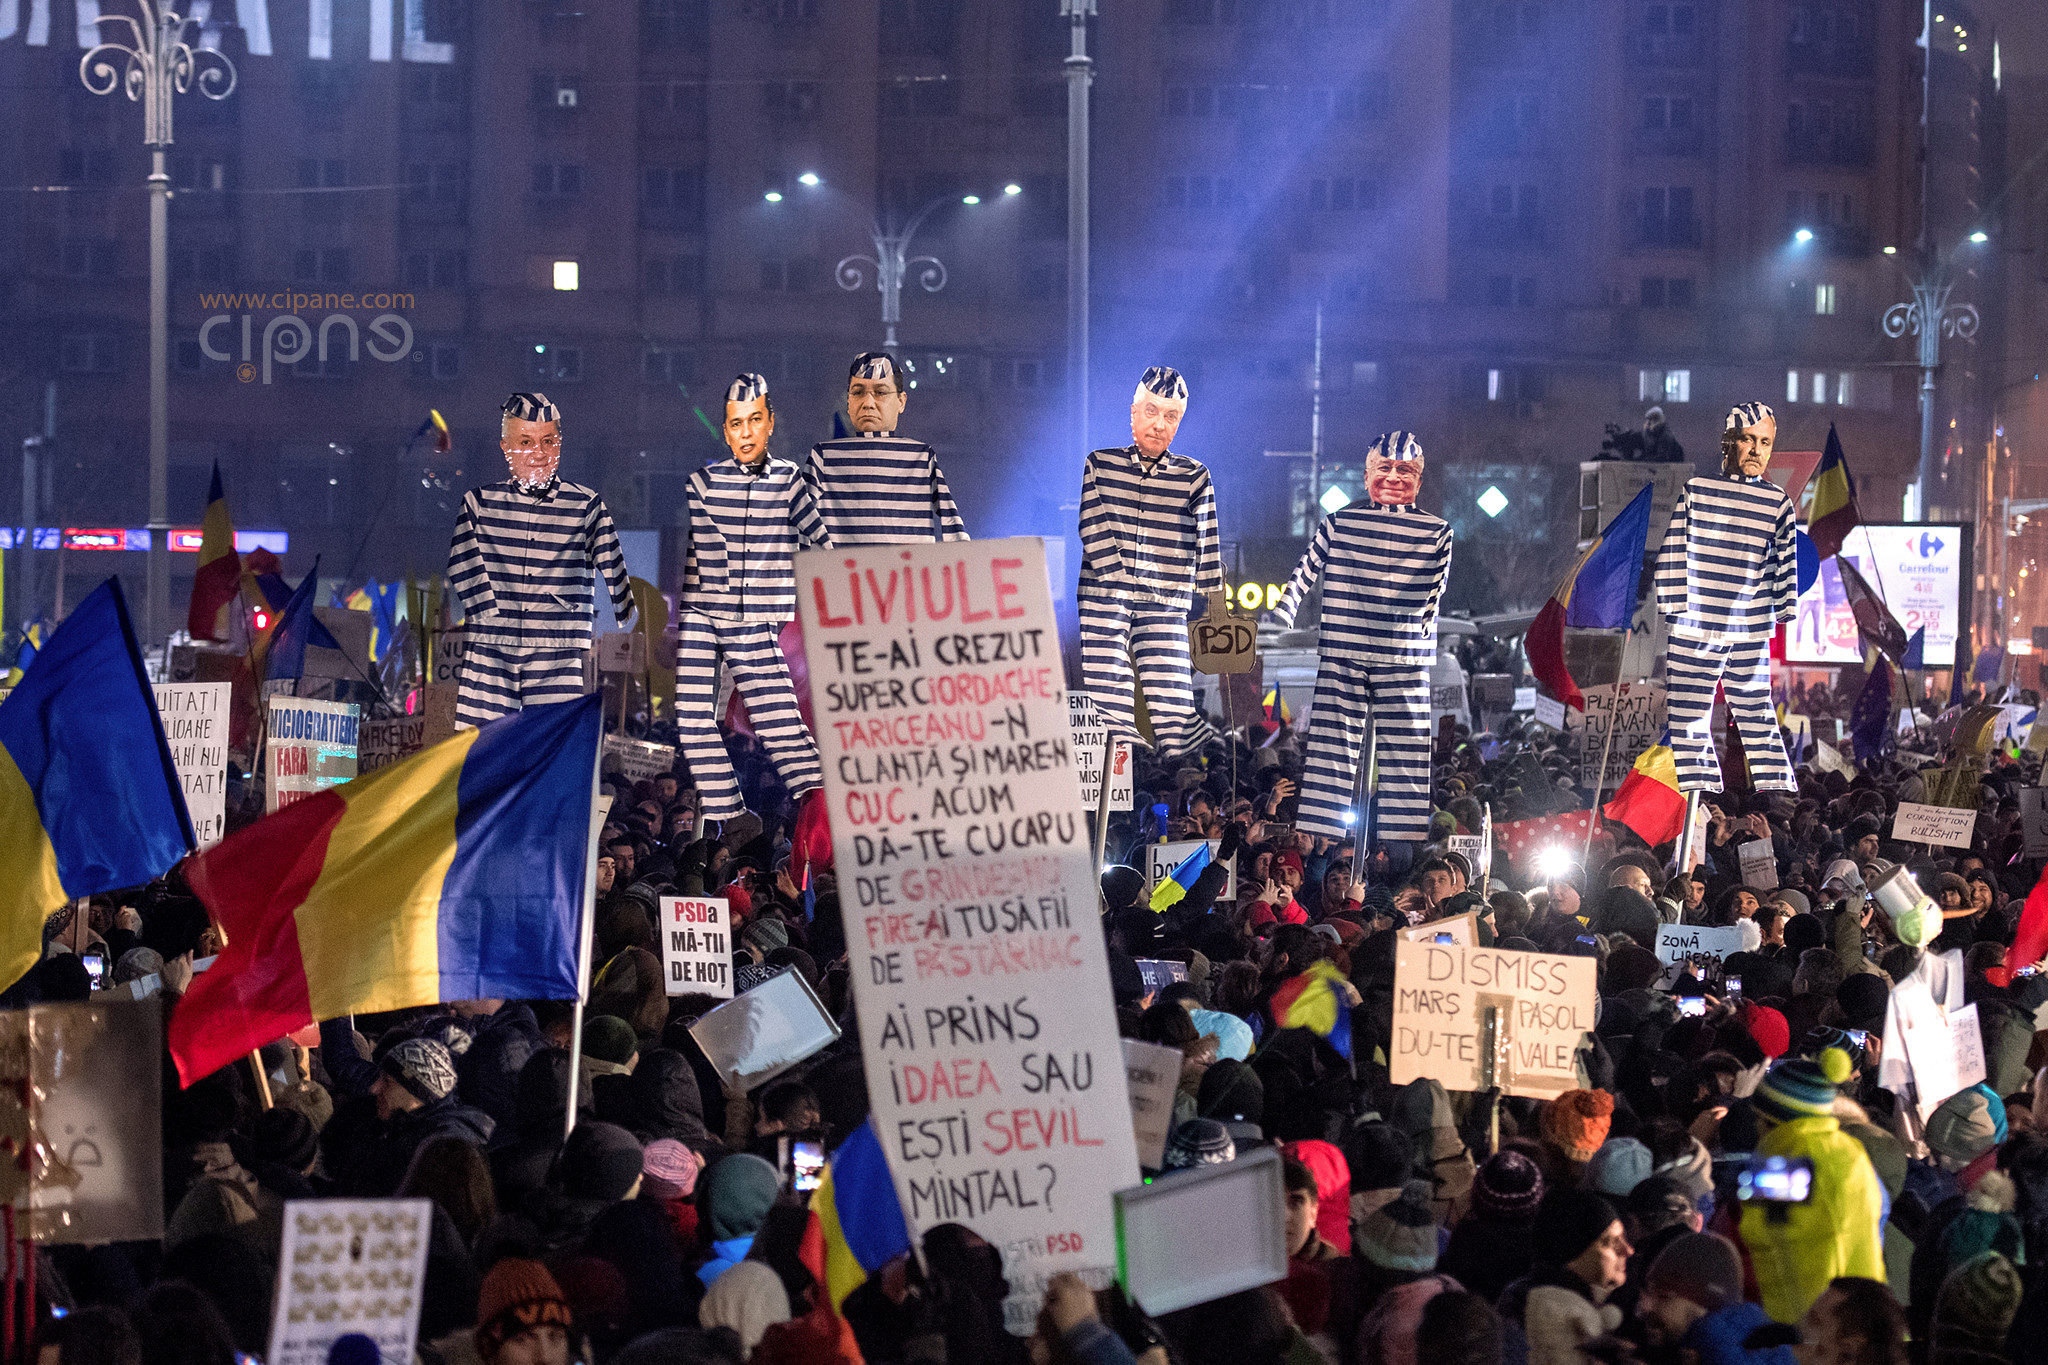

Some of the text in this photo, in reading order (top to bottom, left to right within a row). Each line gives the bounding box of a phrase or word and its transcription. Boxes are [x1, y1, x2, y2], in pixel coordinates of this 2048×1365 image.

[934, 629, 1044, 666] CREZUT
[1198, 625, 1253, 655] PSD
[200, 746, 221, 767] NU
[931, 783, 1015, 820] ACUM
[1906, 812, 1969, 827] CORRUPTION
[1910, 826, 1963, 841] BULLSHIT
[856, 875, 896, 907] DE
[674, 901, 718, 924] PSDa
[1662, 931, 1700, 950] ZONĂ
[671, 960, 728, 990] DE HOȚ
[870, 952, 904, 986] DE
[1425, 948, 1568, 996] DISMISS
[924, 995, 1041, 1047] PRINS
[1399, 988, 1587, 1036] MARȘ PAȘOL
[1399, 1026, 1475, 1062] DU-TE
[1021, 1052, 1093, 1094] SAU
[981, 1099, 1104, 1156] SEVIL
[1046, 1232, 1084, 1255] PSD
